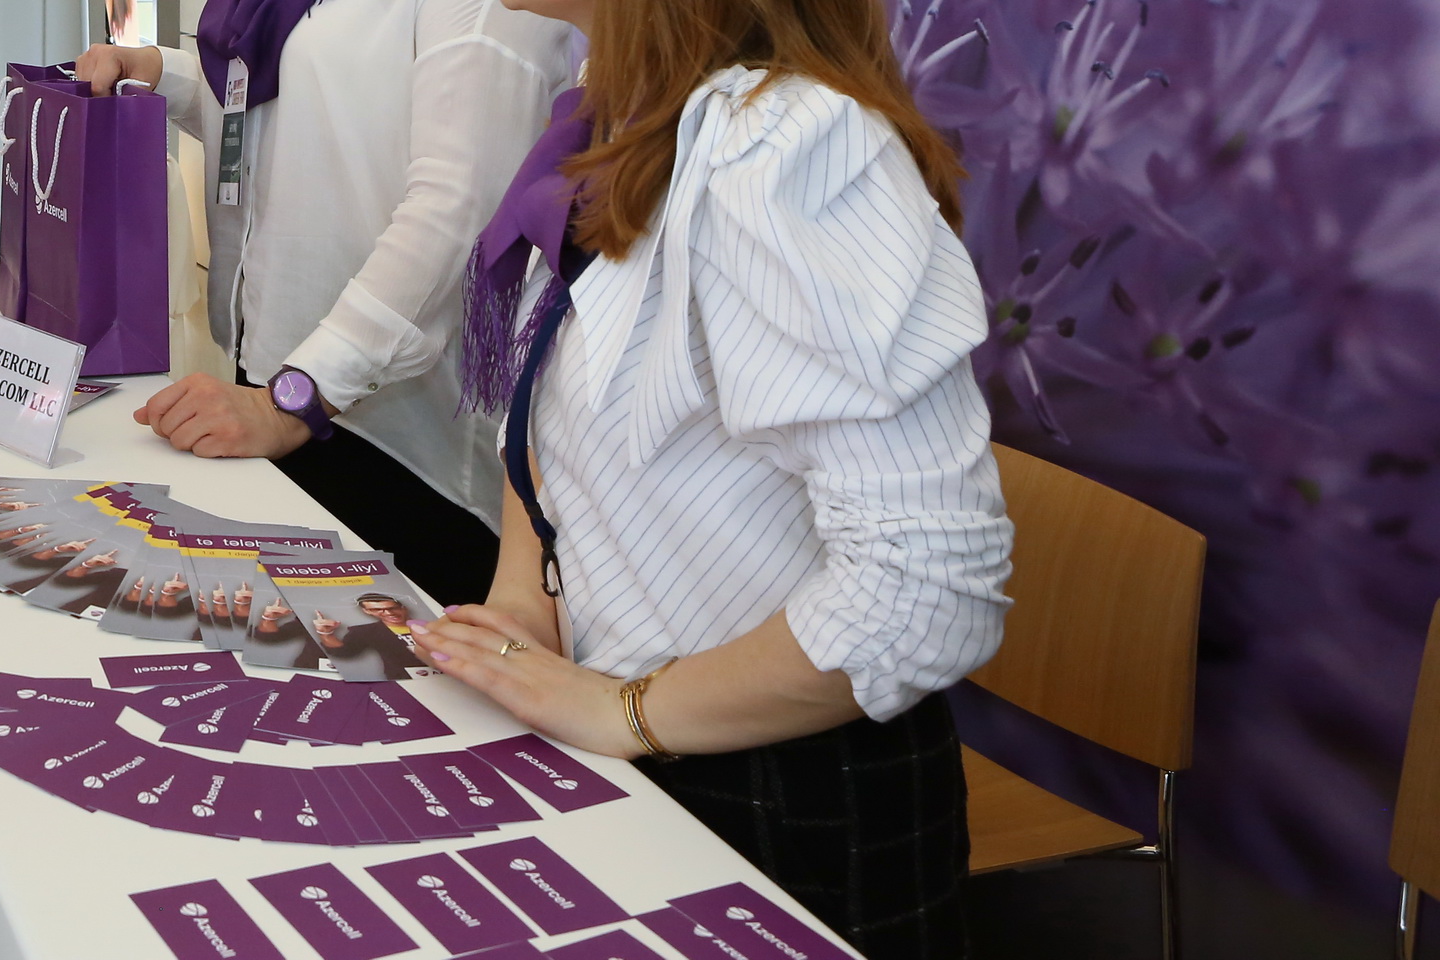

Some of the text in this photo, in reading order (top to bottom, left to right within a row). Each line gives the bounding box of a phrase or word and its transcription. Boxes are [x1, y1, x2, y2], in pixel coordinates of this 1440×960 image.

[44, 200, 68, 222] Azercell
[29, 392, 57, 417] LLC
[276, 562, 378, 575] tələbə 1-liyi
[133, 664, 189, 674] Azercell
[37, 693, 95, 708] Azercell
[182, 683, 229, 702] Azercell
[296, 697, 323, 723] Azercell
[101, 755, 146, 781] Azercell
[515, 751, 563, 779] Azercell
[201, 774, 226, 806] Azercell
[403, 772, 440, 804] Azercell
[445, 765, 482, 795] Azercell
[524, 872, 576, 910] Azercell
[315, 900, 363, 940] Azercell
[432, 889, 481, 928] Azercell
[193, 917, 237, 959] Azercell
